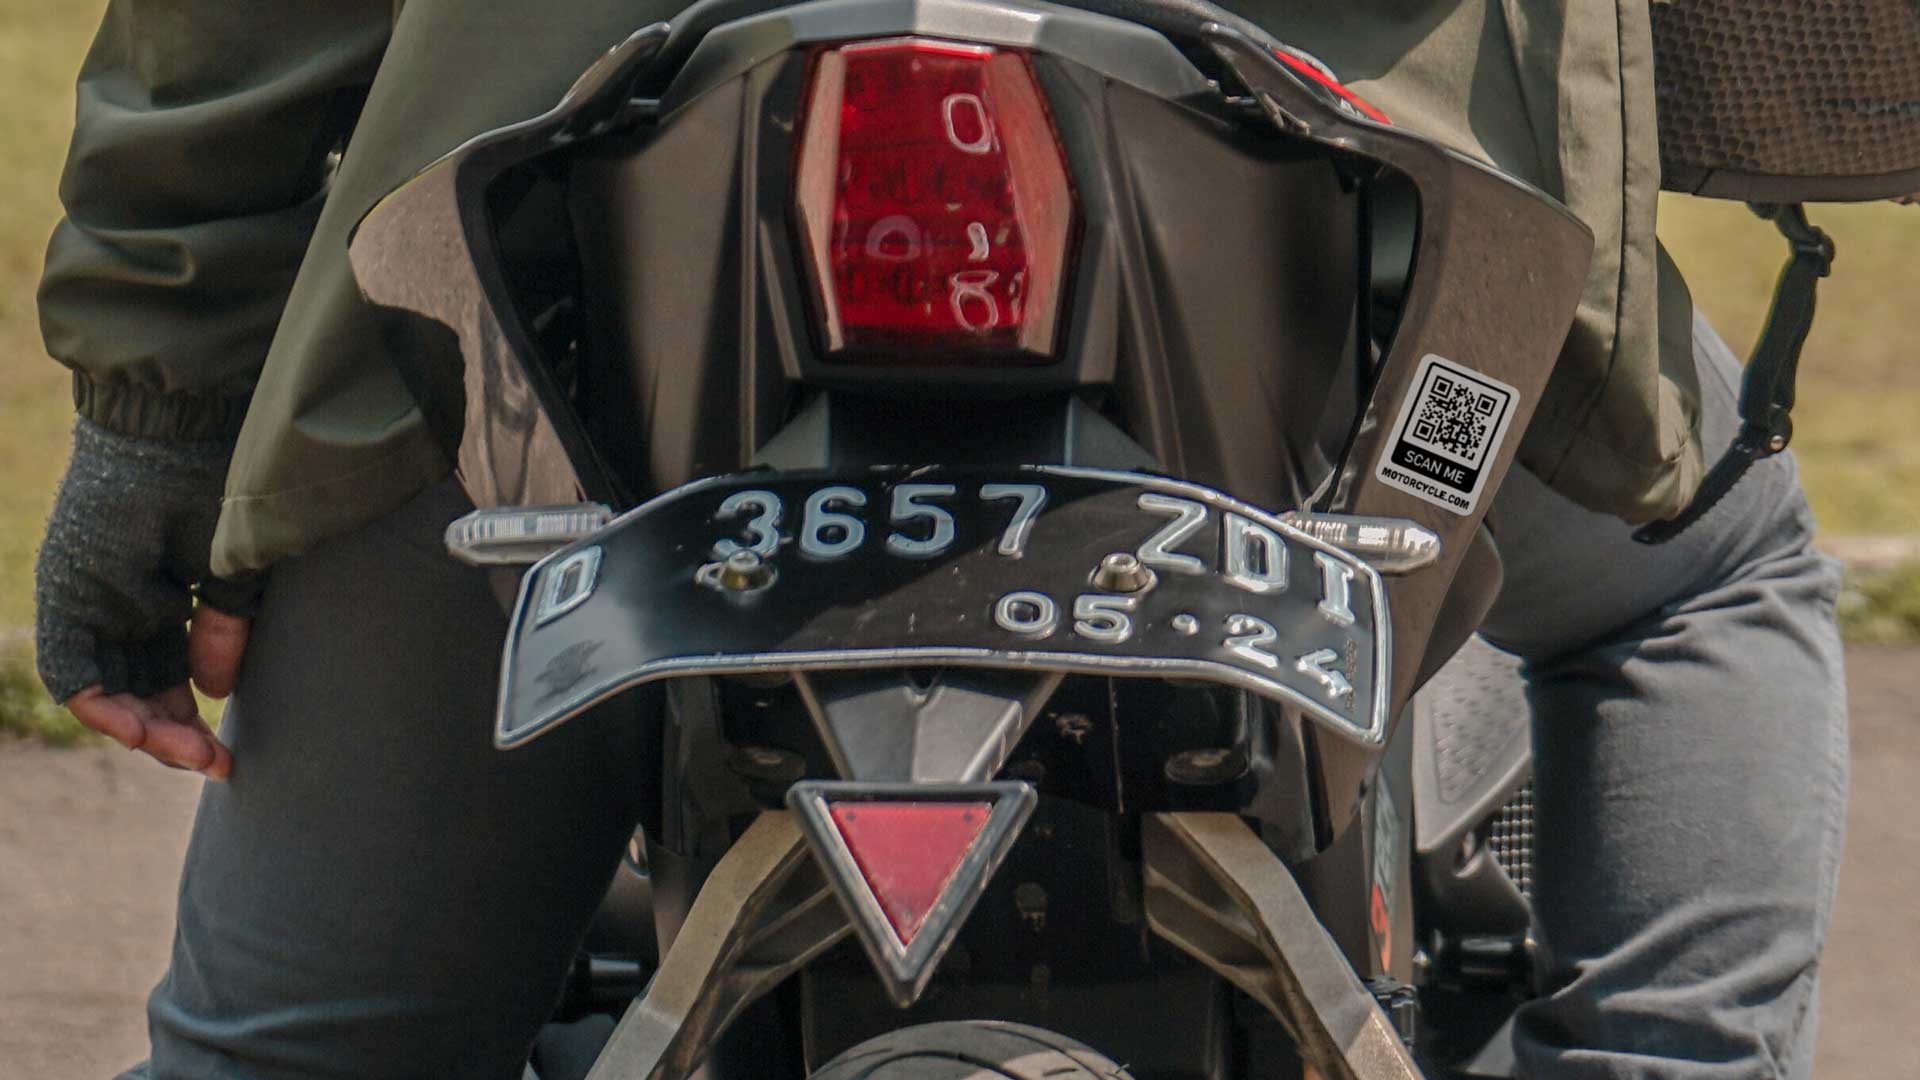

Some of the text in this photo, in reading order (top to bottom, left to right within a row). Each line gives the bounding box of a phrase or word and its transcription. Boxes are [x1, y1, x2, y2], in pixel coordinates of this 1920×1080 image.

[1382, 467, 1470, 510] MOTORCYCLE.COM
[1404, 451, 1466, 484] SCAN ME
[534, 483, 1355, 627] D 3657 ZDI
